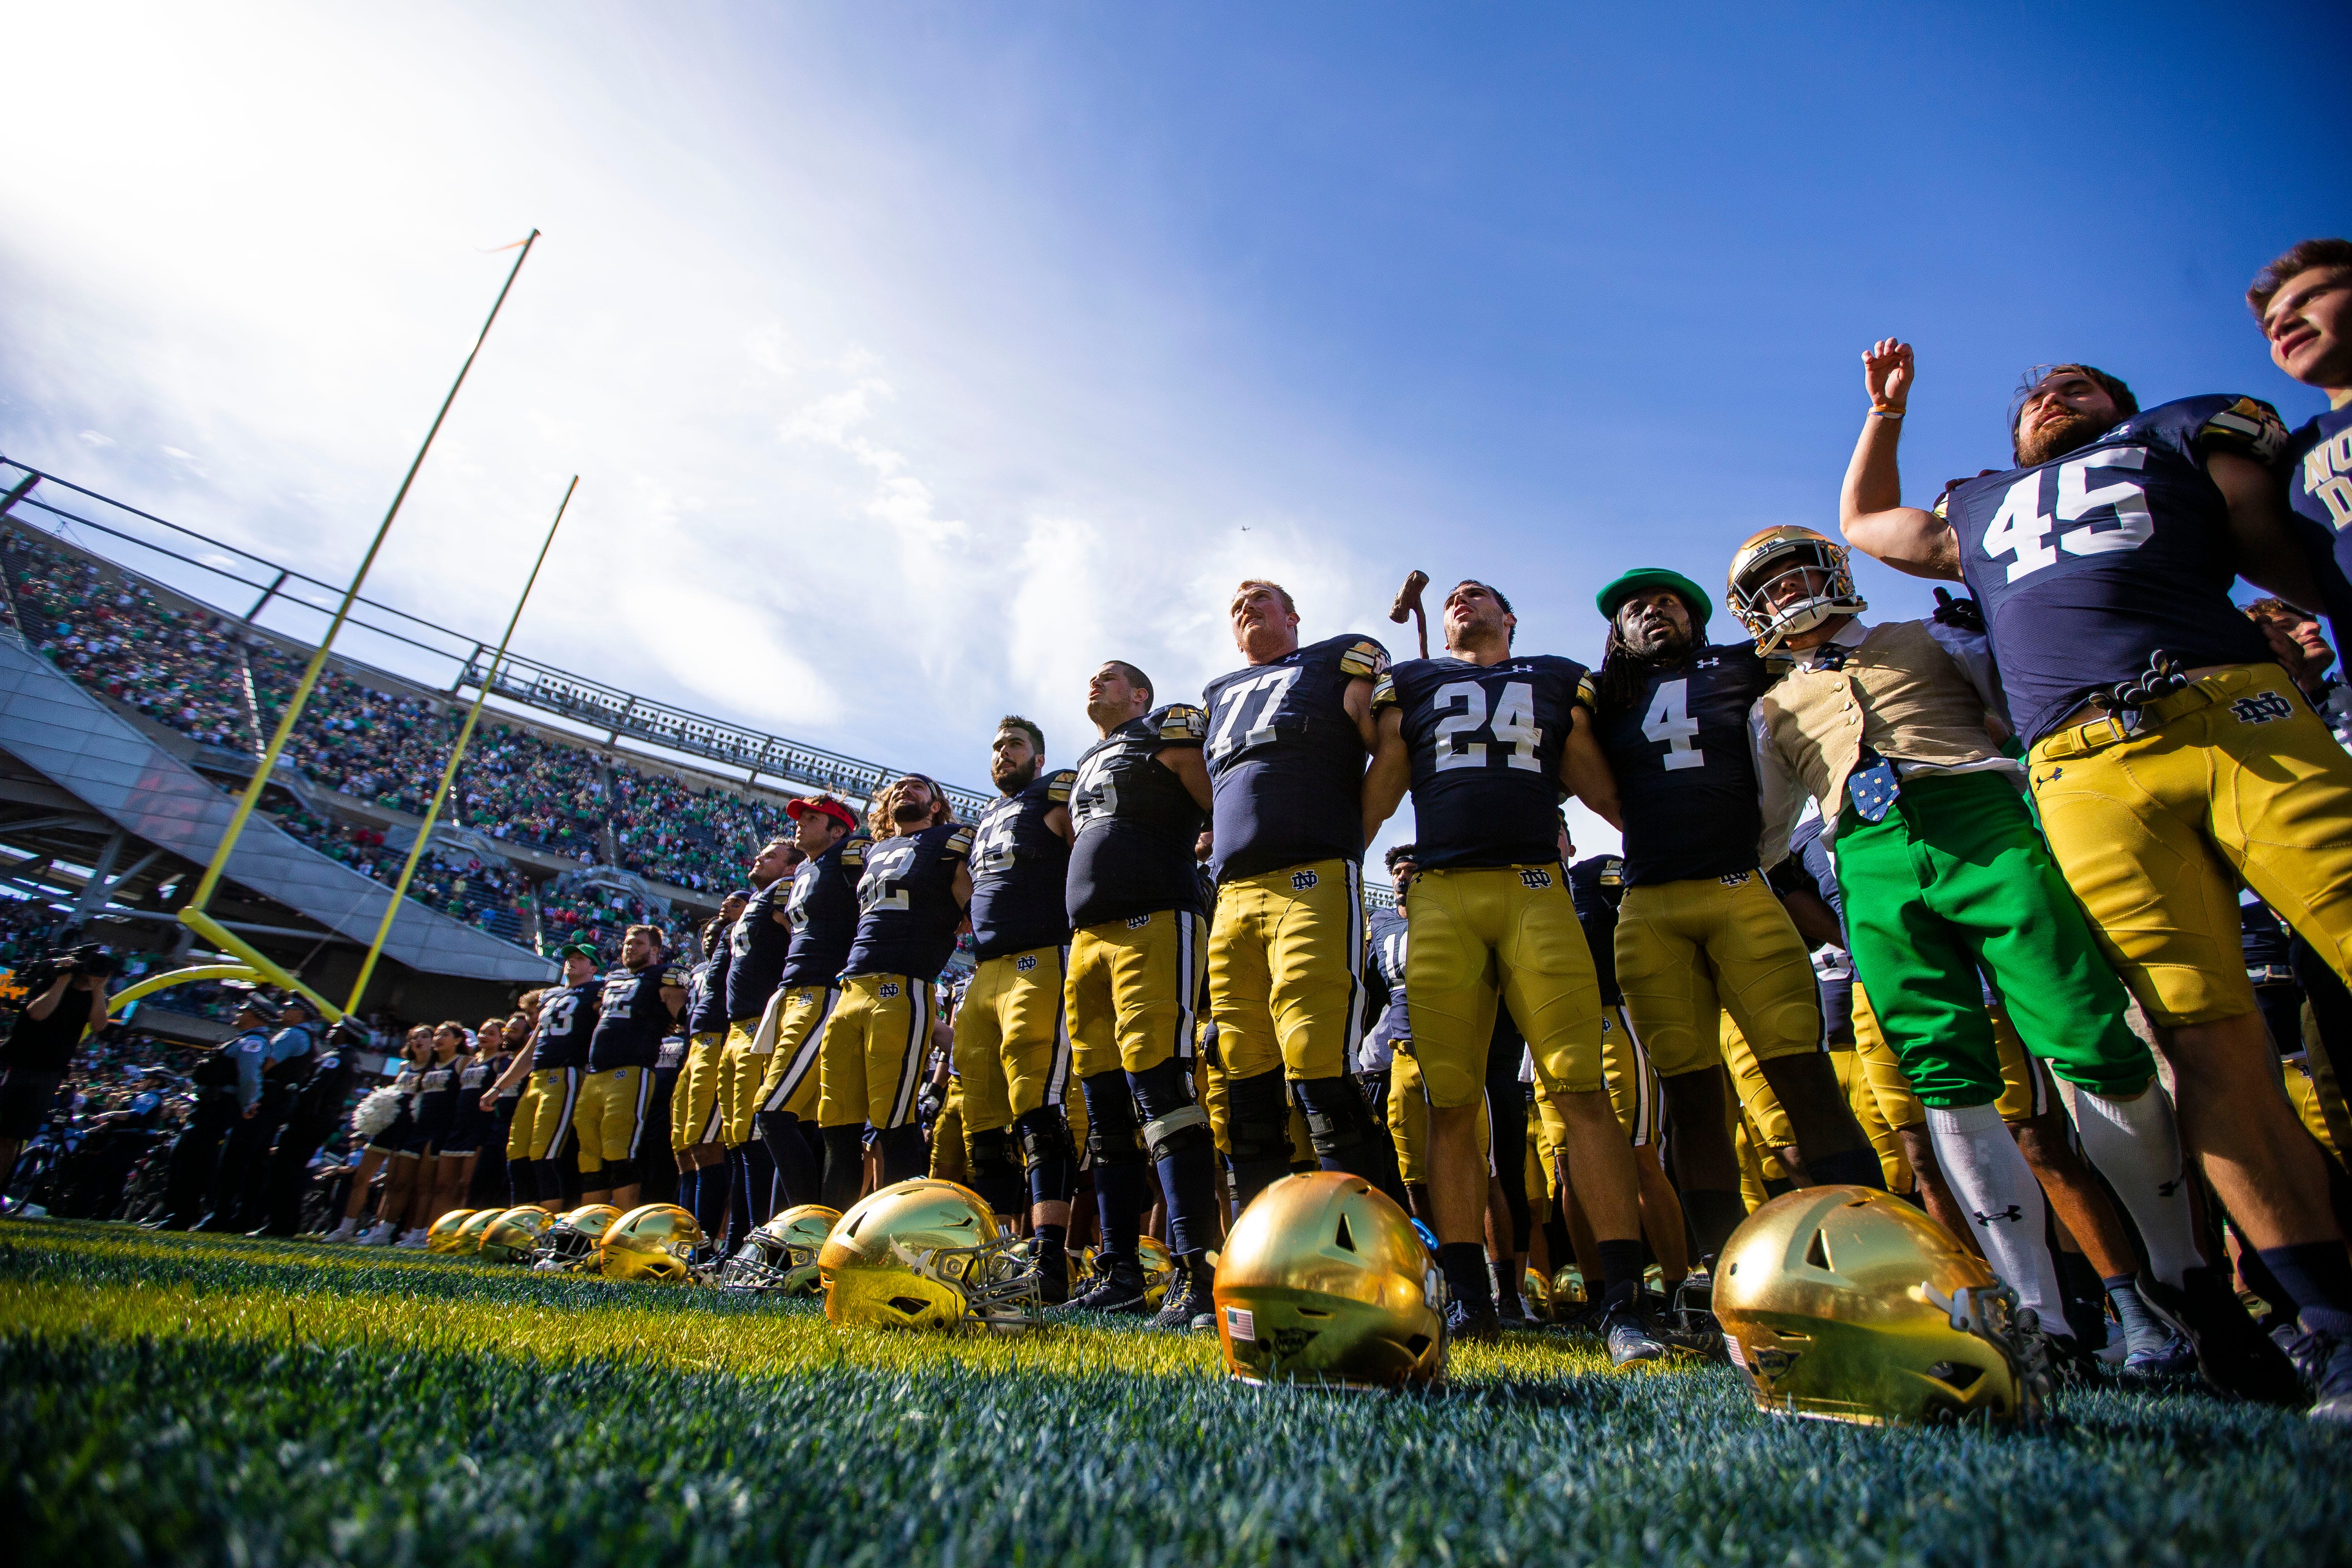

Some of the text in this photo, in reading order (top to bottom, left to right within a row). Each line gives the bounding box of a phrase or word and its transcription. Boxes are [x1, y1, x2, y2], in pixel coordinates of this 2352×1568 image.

[1982, 447, 2154, 585] 45
[1210, 666, 1304, 761] 77
[1434, 681, 1543, 773] 24
[1641, 678, 1705, 771] 4
[1124, 1295, 1143, 1306] ARMOUR
